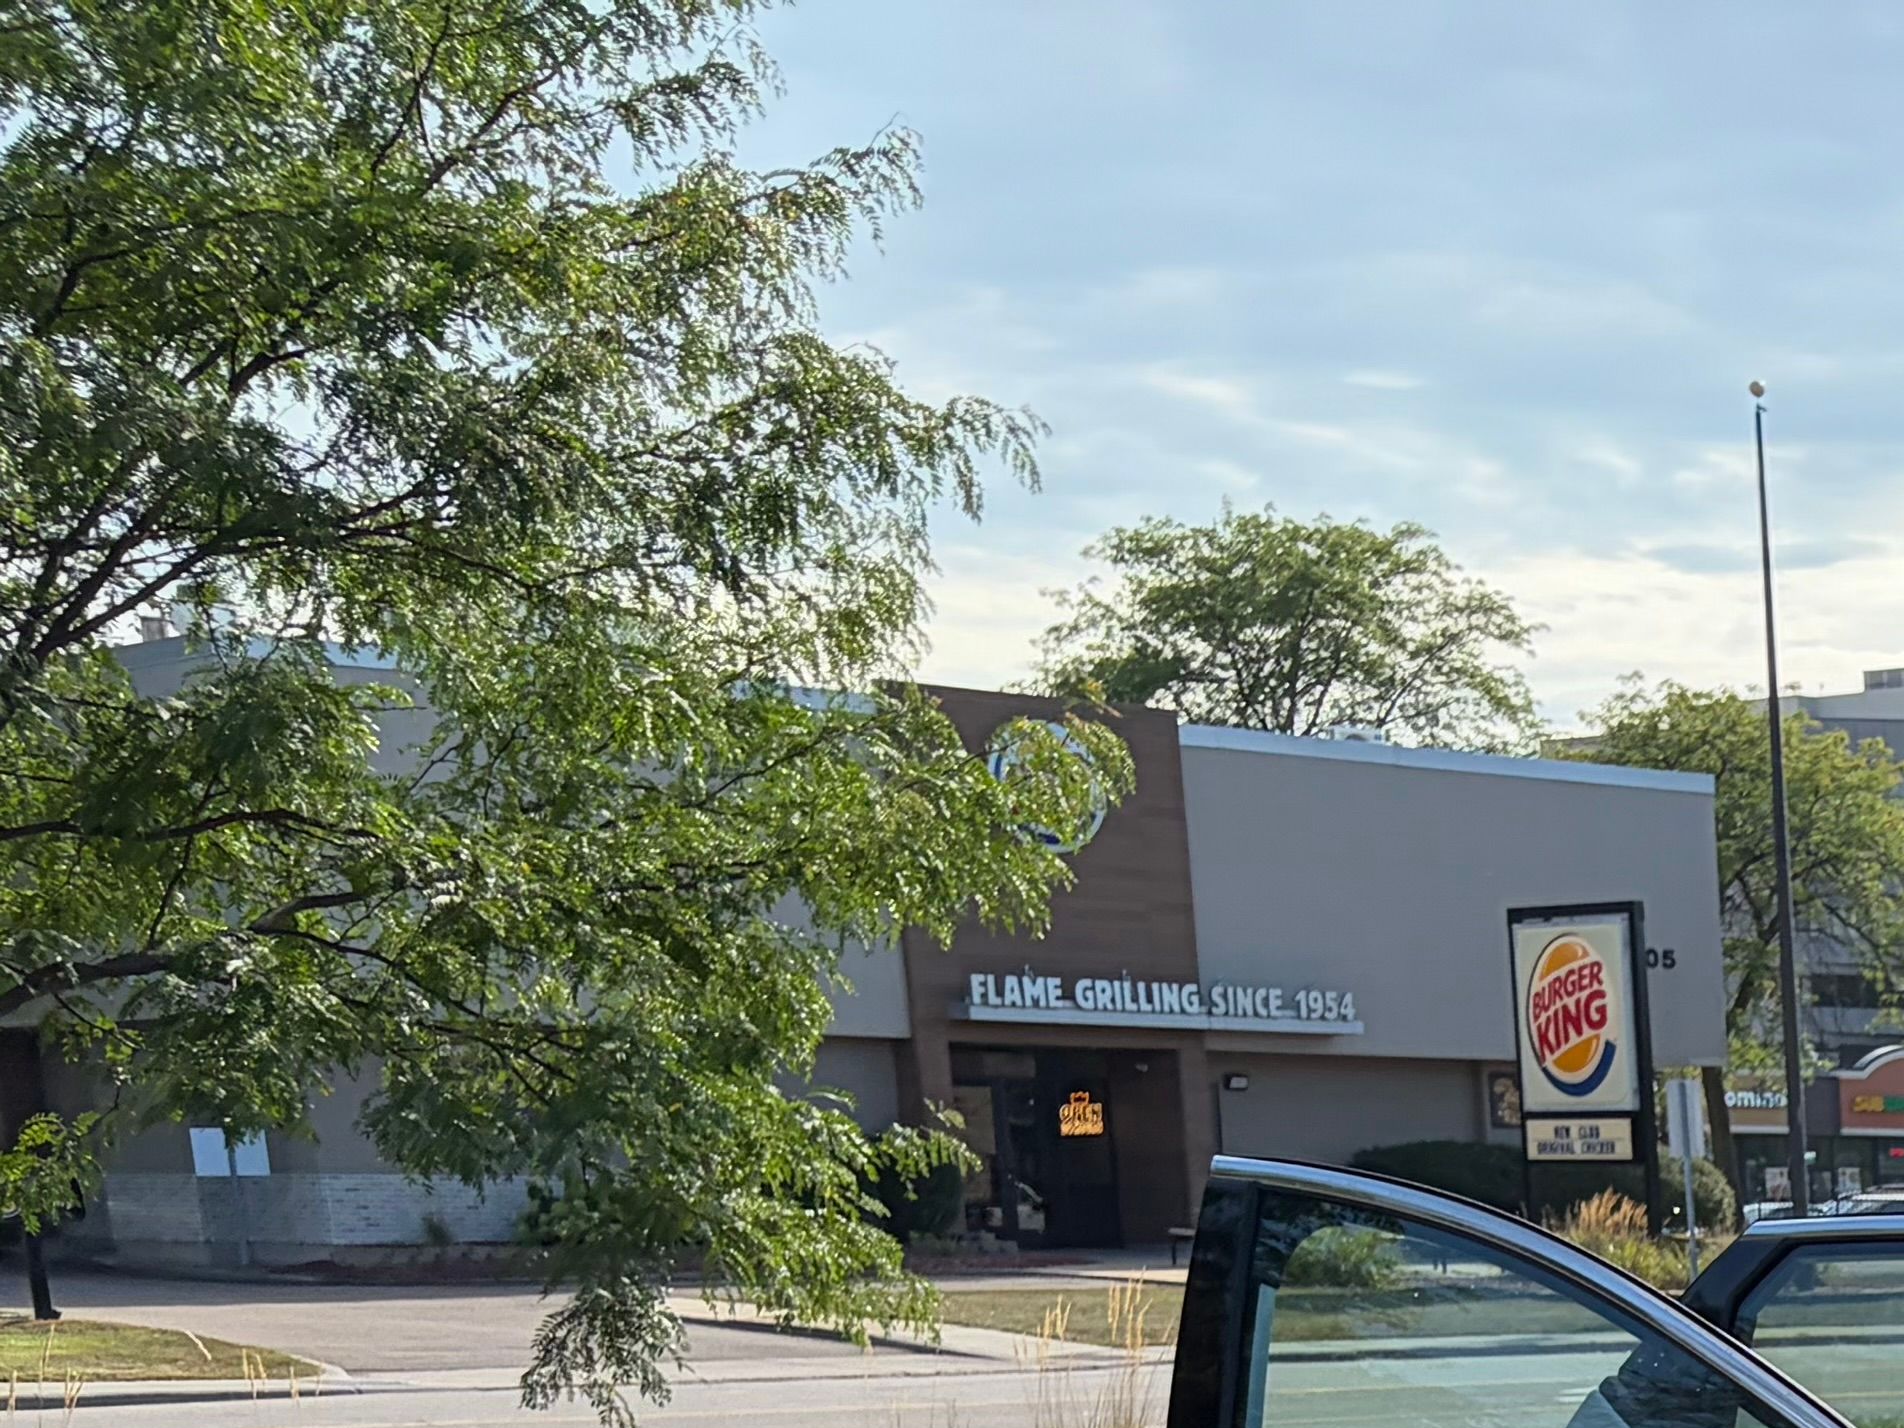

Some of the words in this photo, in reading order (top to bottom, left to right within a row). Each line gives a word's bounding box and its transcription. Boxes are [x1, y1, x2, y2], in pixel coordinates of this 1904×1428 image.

[970, 973, 1064, 1008] FLAME
[1074, 978, 1200, 1015] GRILLING
[1210, 984, 1283, 1018] SINCE
[1294, 989, 1357, 1022] 1954
[1533, 961, 1604, 1023] BURGER
[1536, 989, 1608, 1067] KING
